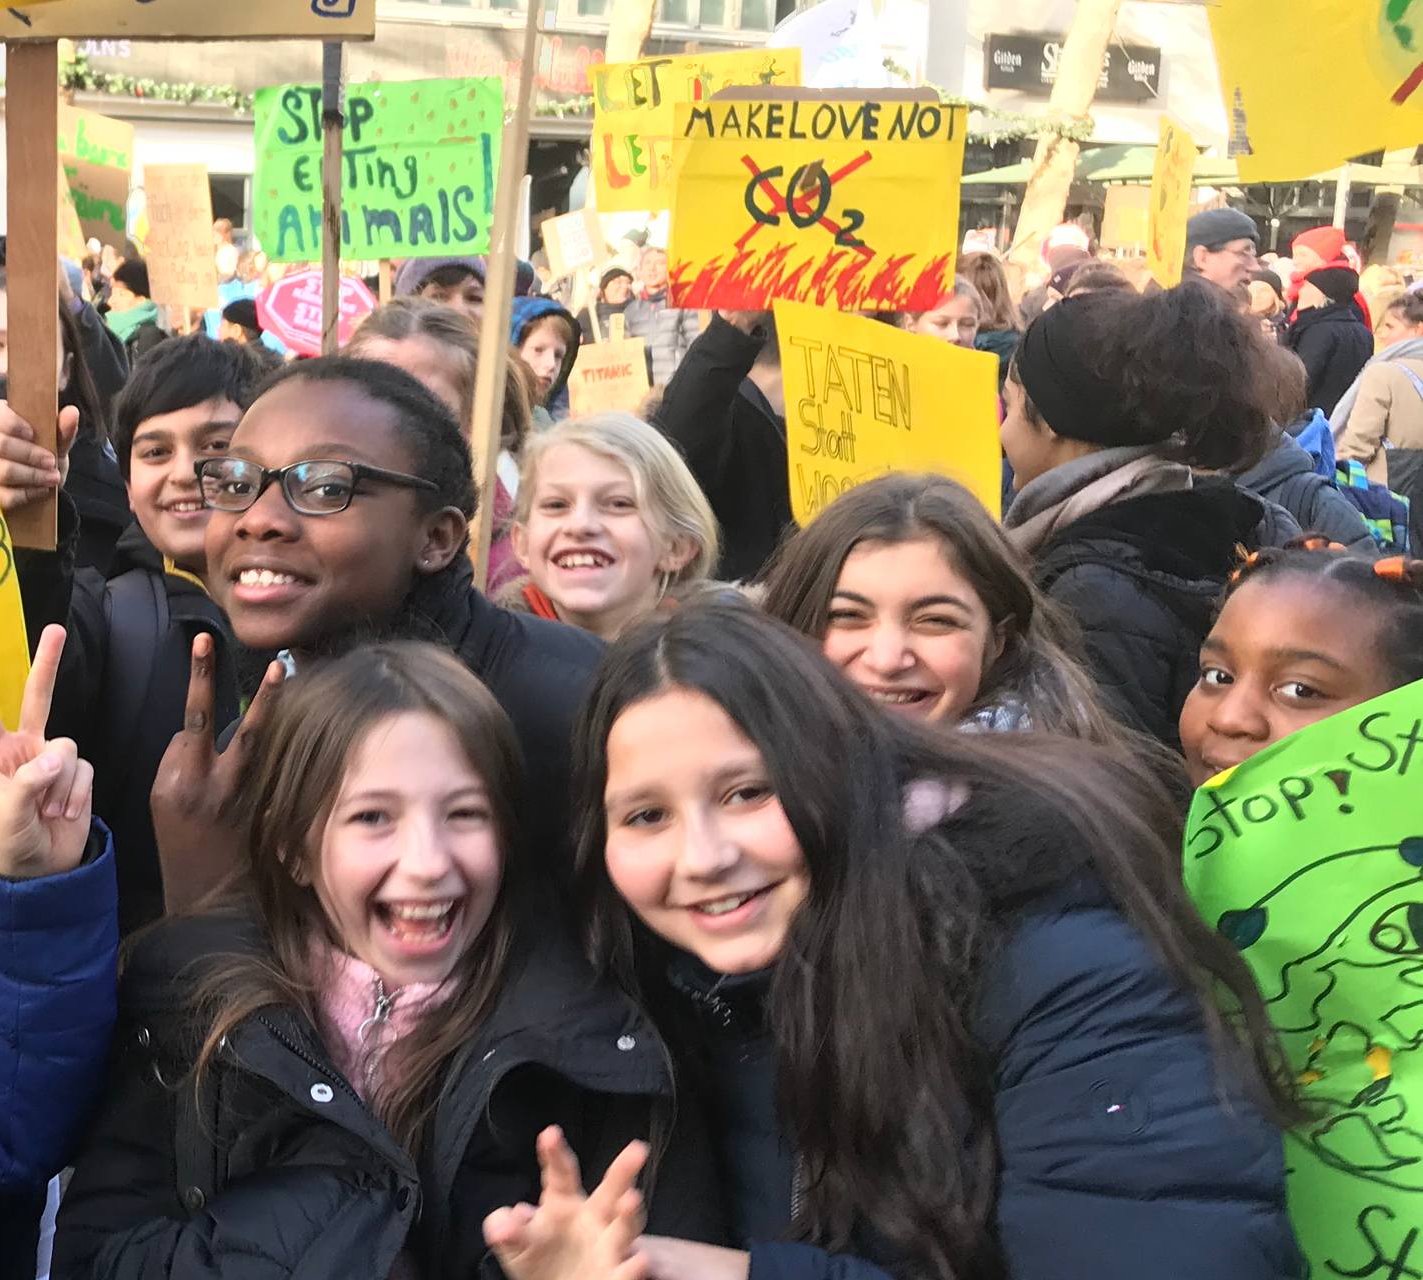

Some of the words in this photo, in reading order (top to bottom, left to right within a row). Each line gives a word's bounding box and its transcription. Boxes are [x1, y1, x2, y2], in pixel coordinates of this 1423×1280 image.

[277, 86, 374, 144] STP
[596, 59, 673, 113] LET
[886, 102, 967, 141] NOT
[293, 145, 418, 199] ETing
[603, 132, 674, 190] LET
[789, 335, 912, 431] TATEN
[797, 397, 857, 464] Statt
[1187, 768, 1355, 860] Stop!
